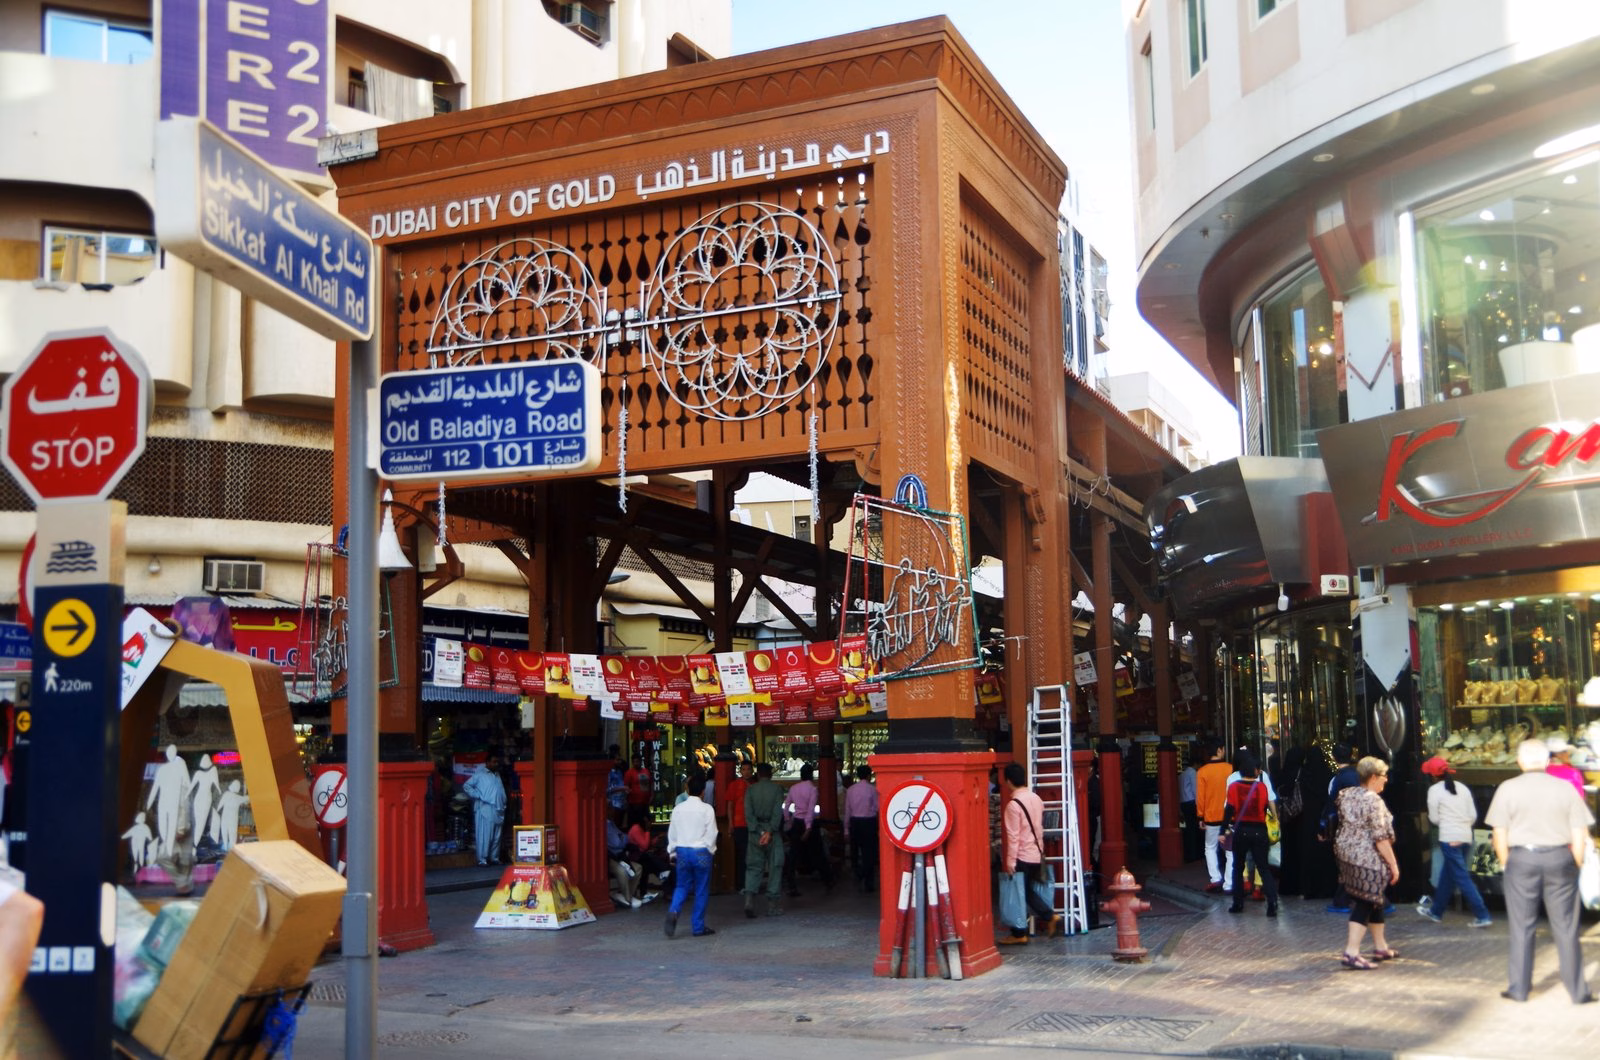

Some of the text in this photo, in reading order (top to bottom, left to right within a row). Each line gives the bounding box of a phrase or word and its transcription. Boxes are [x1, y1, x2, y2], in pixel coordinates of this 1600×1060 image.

[636, 130, 890, 200] دبي مدينة الذهب
[204, 148, 365, 279] شارع سكة الخيل
[370, 174, 616, 239] DUBAI CITY OF GOLD
[205, 198, 364, 324] Sikkat Al Khail Rd
[27, 350, 121, 415] قف
[386, 368, 582, 418] شارع البلدية القديم
[386, 408, 582, 443] Old Baladiya Road
[31, 436, 115, 471] STOP
[389, 449, 432, 463] المنطقة
[442, 449, 471, 467] 112
[493, 442, 533, 466] 101
[544, 439, 580, 454] شارع
[544, 453, 580, 465] Road
[389, 464, 432, 474] COMMUNITY
[60, 679, 92, 692] 220m
[652, 740, 660, 791] WATCH
